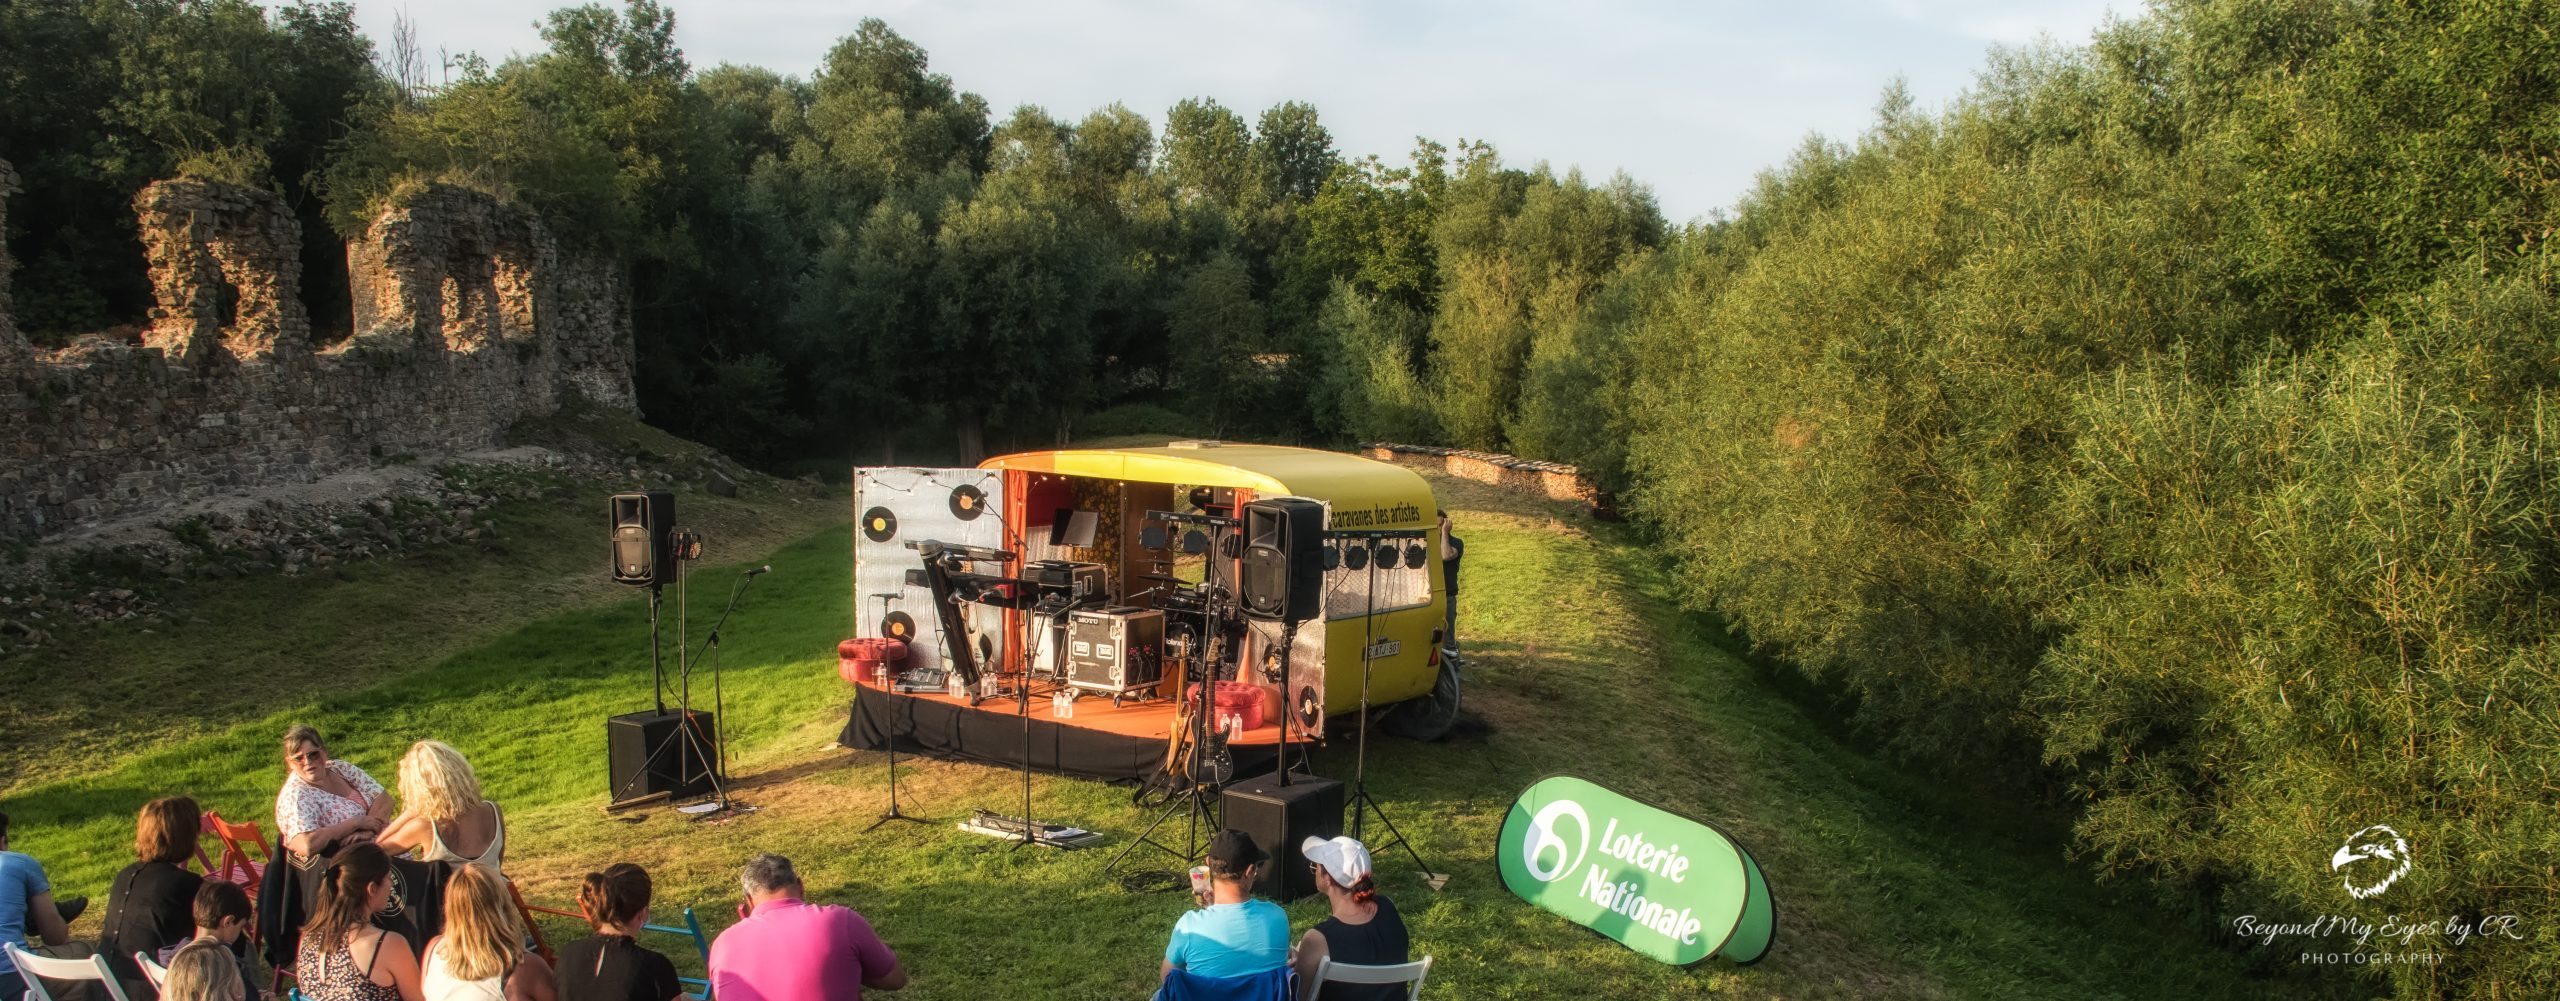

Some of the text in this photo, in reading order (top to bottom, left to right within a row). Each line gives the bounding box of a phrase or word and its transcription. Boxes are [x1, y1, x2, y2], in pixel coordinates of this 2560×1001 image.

[1331, 501, 1420, 528] caravanes des artistes
[1078, 617, 1099, 625] MOTU
[1598, 817, 1689, 883] Loterie
[1579, 863, 1701, 945] Nationale
